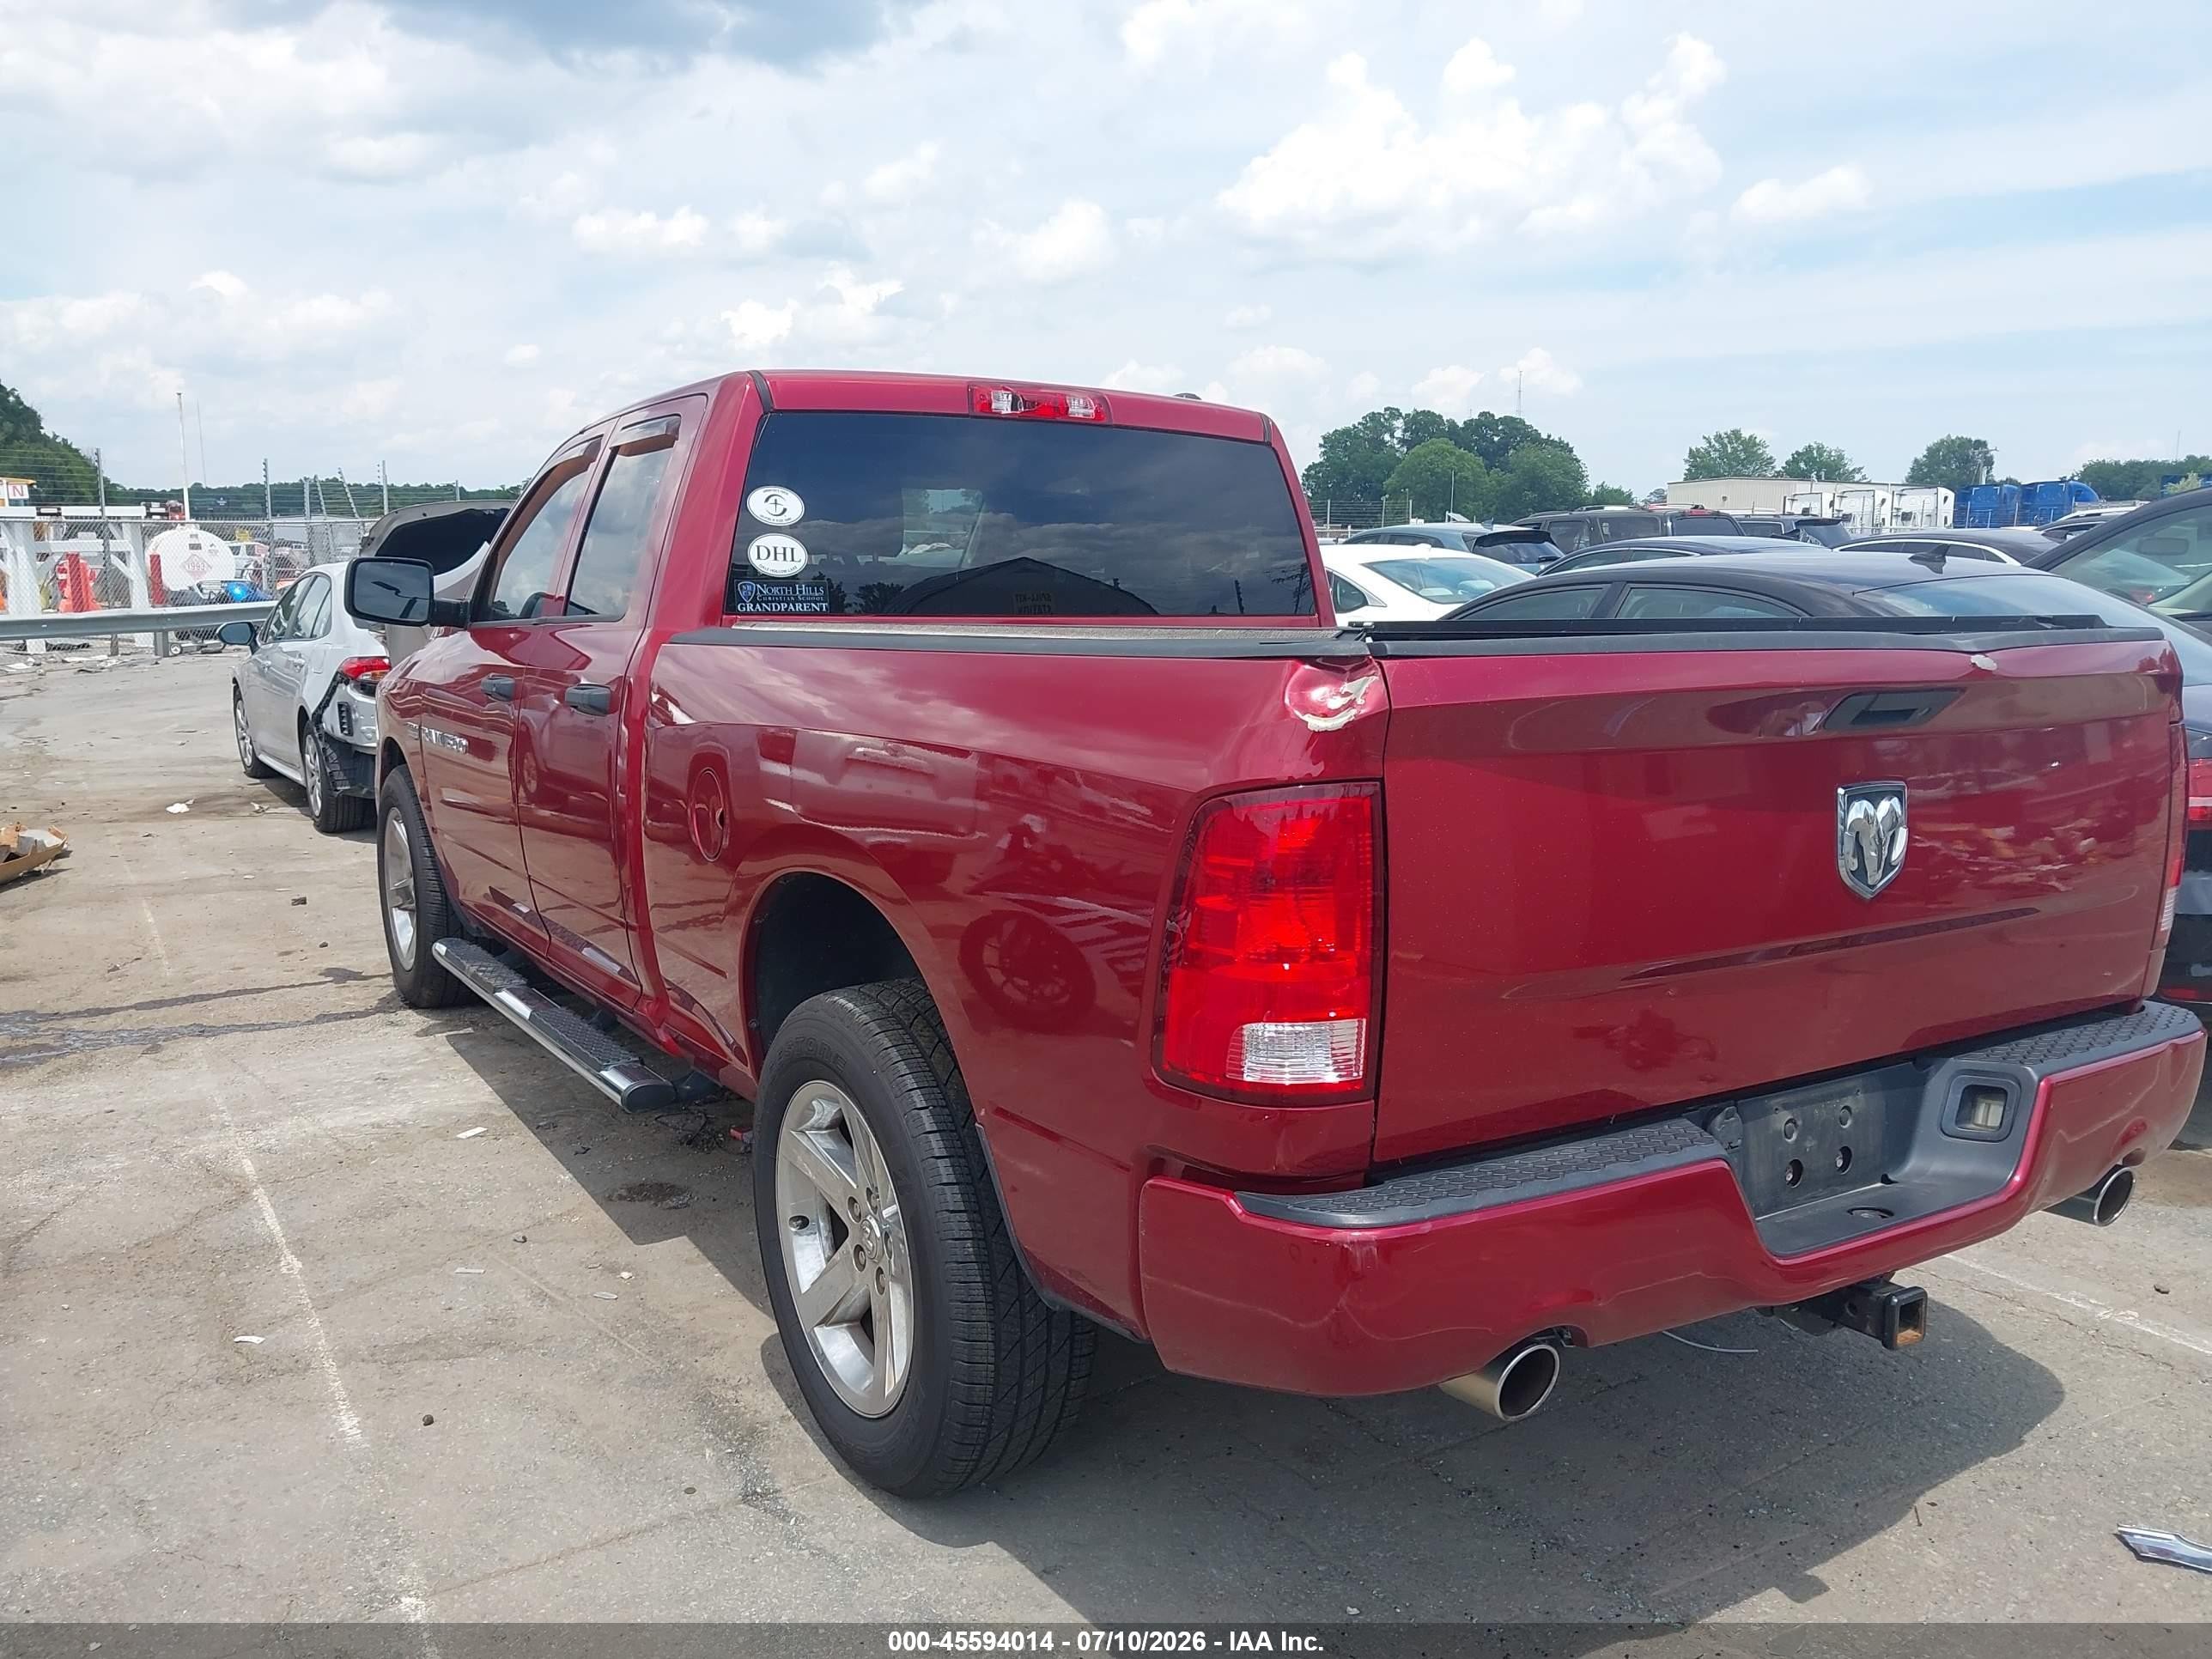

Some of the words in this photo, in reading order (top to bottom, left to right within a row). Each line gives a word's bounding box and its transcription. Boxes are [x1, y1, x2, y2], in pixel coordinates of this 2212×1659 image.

[756, 544, 802, 563] DHL
[756, 584, 793, 595] NORTH
[795, 584, 824, 596] HILLS
[738, 603, 829, 612] GRANDPARENT
